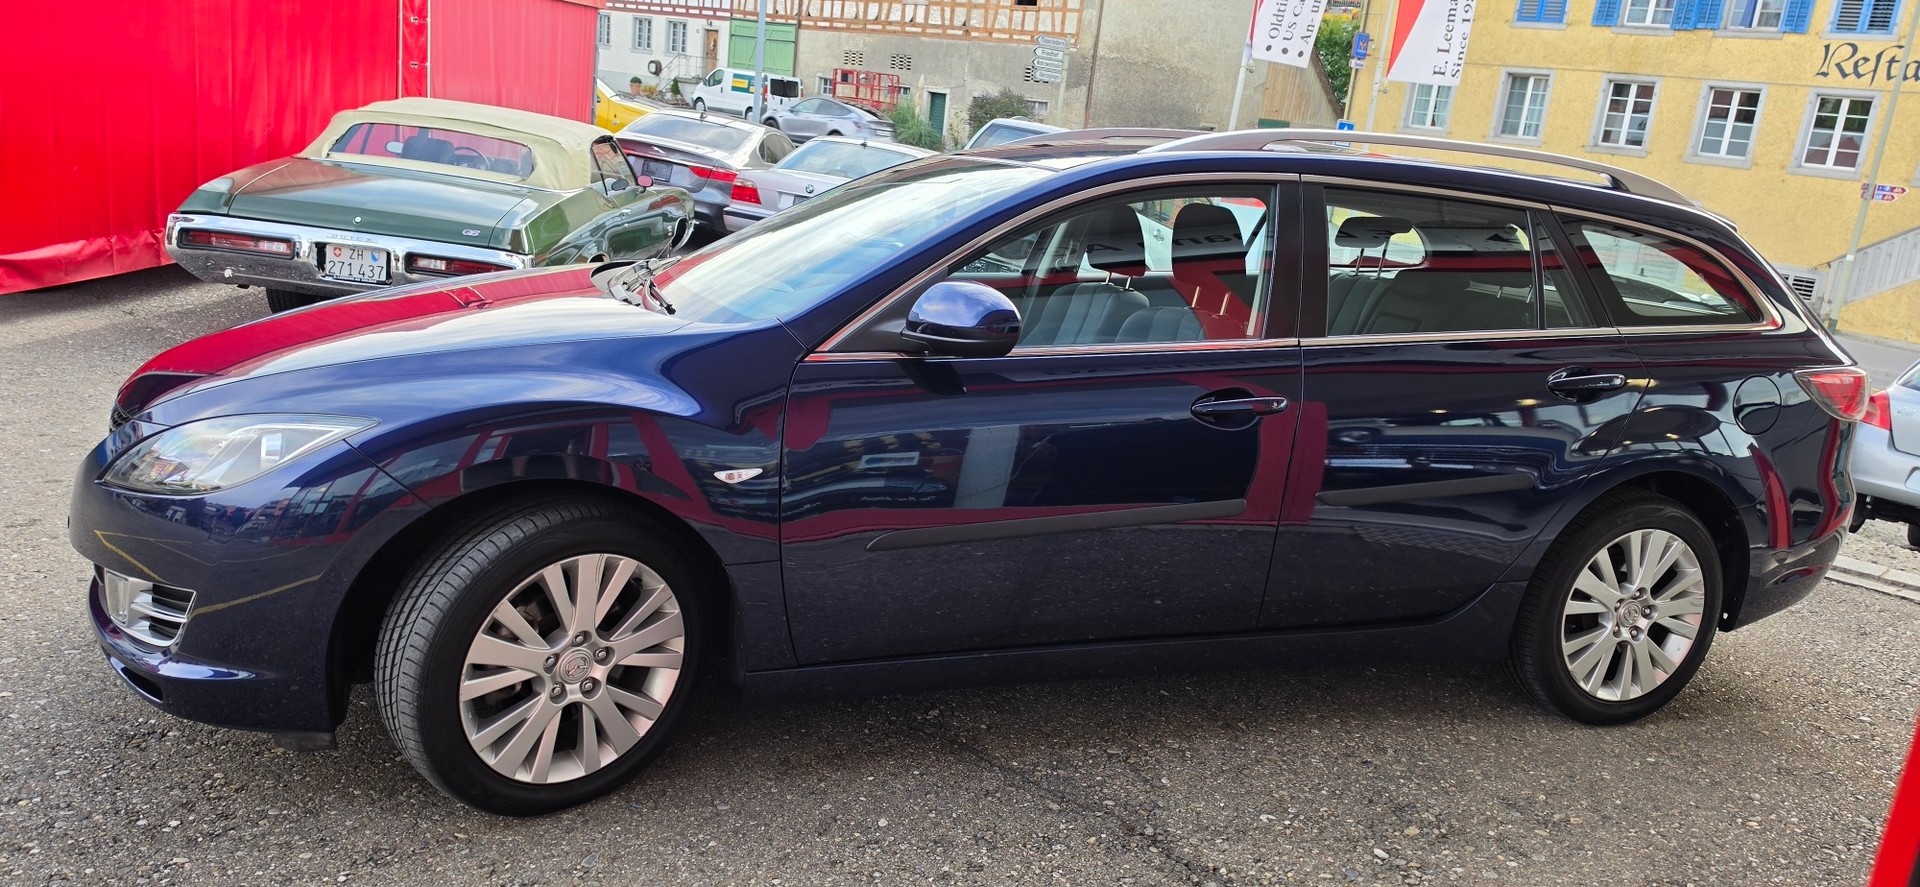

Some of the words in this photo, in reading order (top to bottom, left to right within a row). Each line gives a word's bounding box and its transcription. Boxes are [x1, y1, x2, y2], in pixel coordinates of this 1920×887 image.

[1269, 0, 1288, 39] Oldti
[1282, 21, 1297, 41] US
[1300, 18, 1315, 45] An-
[1451, 32, 1469, 79] Since
[1462, 0, 1474, 24] 19
[1432, 60, 1448, 77] E.
[349, 248, 364, 261] ZH
